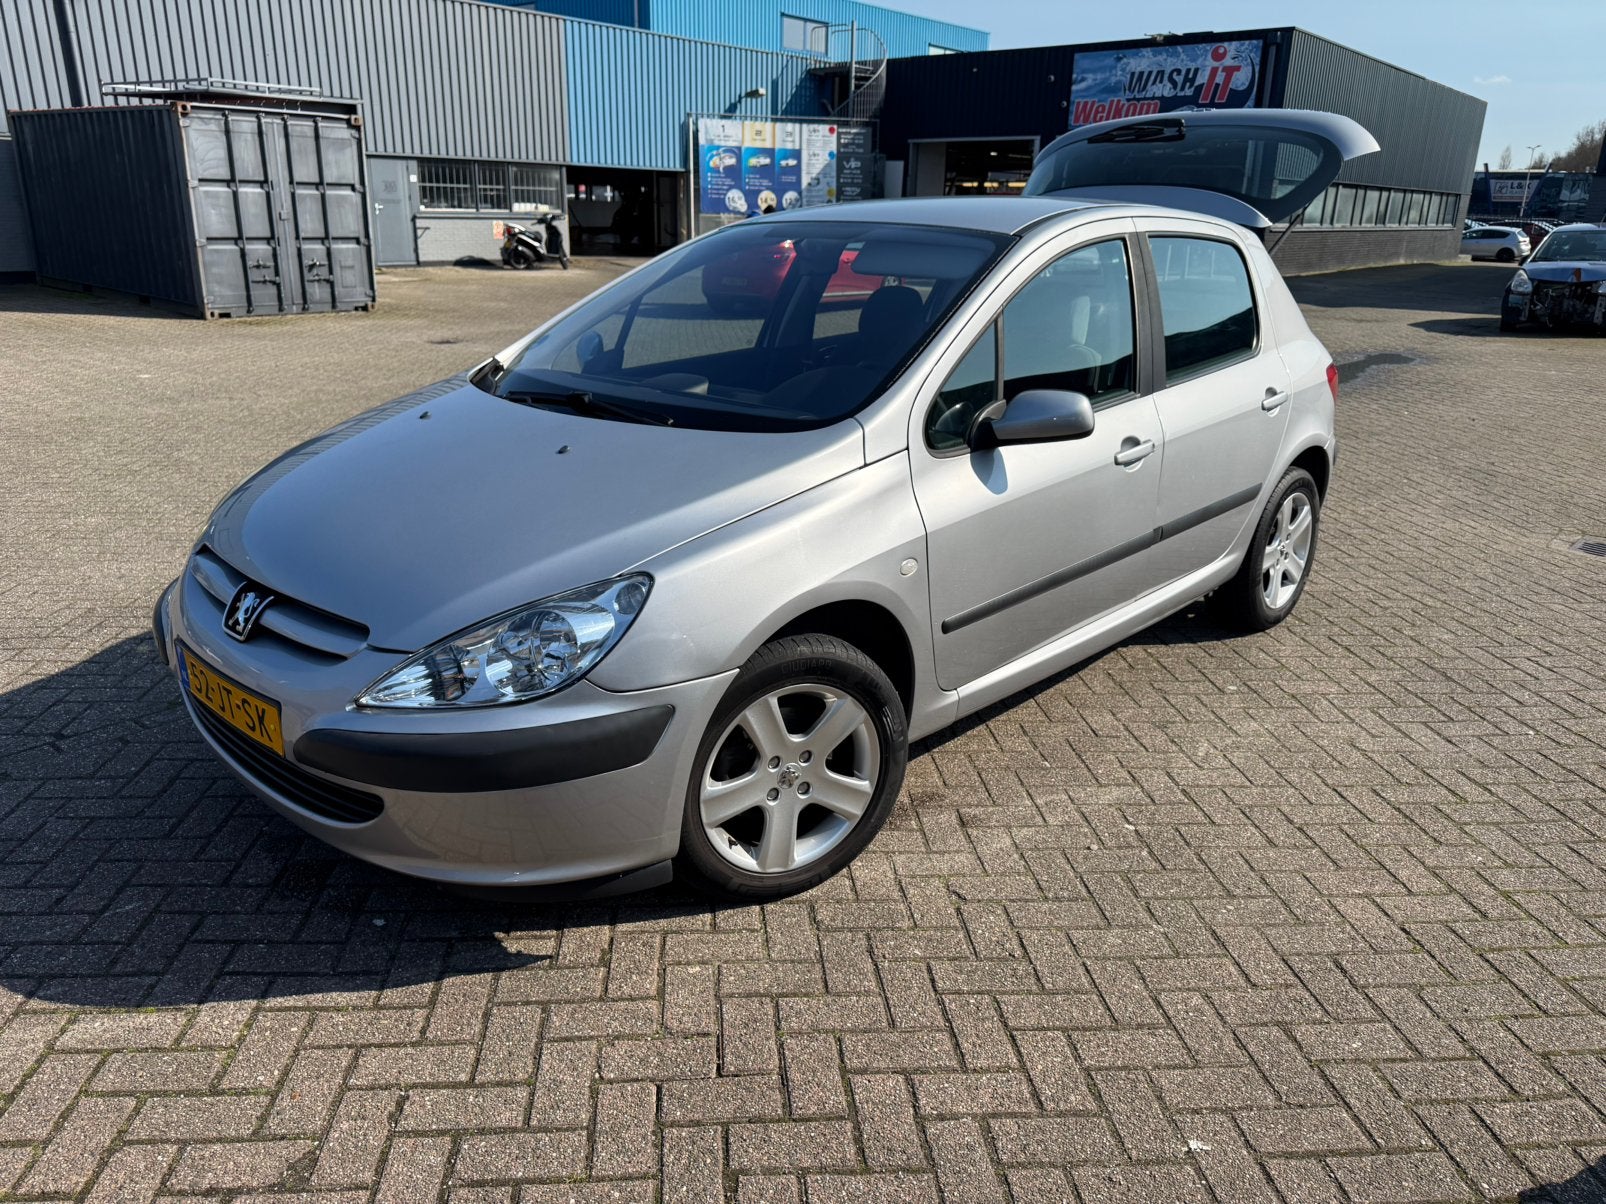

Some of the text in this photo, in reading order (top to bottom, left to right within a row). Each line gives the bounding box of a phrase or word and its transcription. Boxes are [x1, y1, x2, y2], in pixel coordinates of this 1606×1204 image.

[1126, 67, 1199, 98] WASH
[1071, 99, 1160, 126] Welkom
[190, 661, 273, 743] 52-JT-SK
